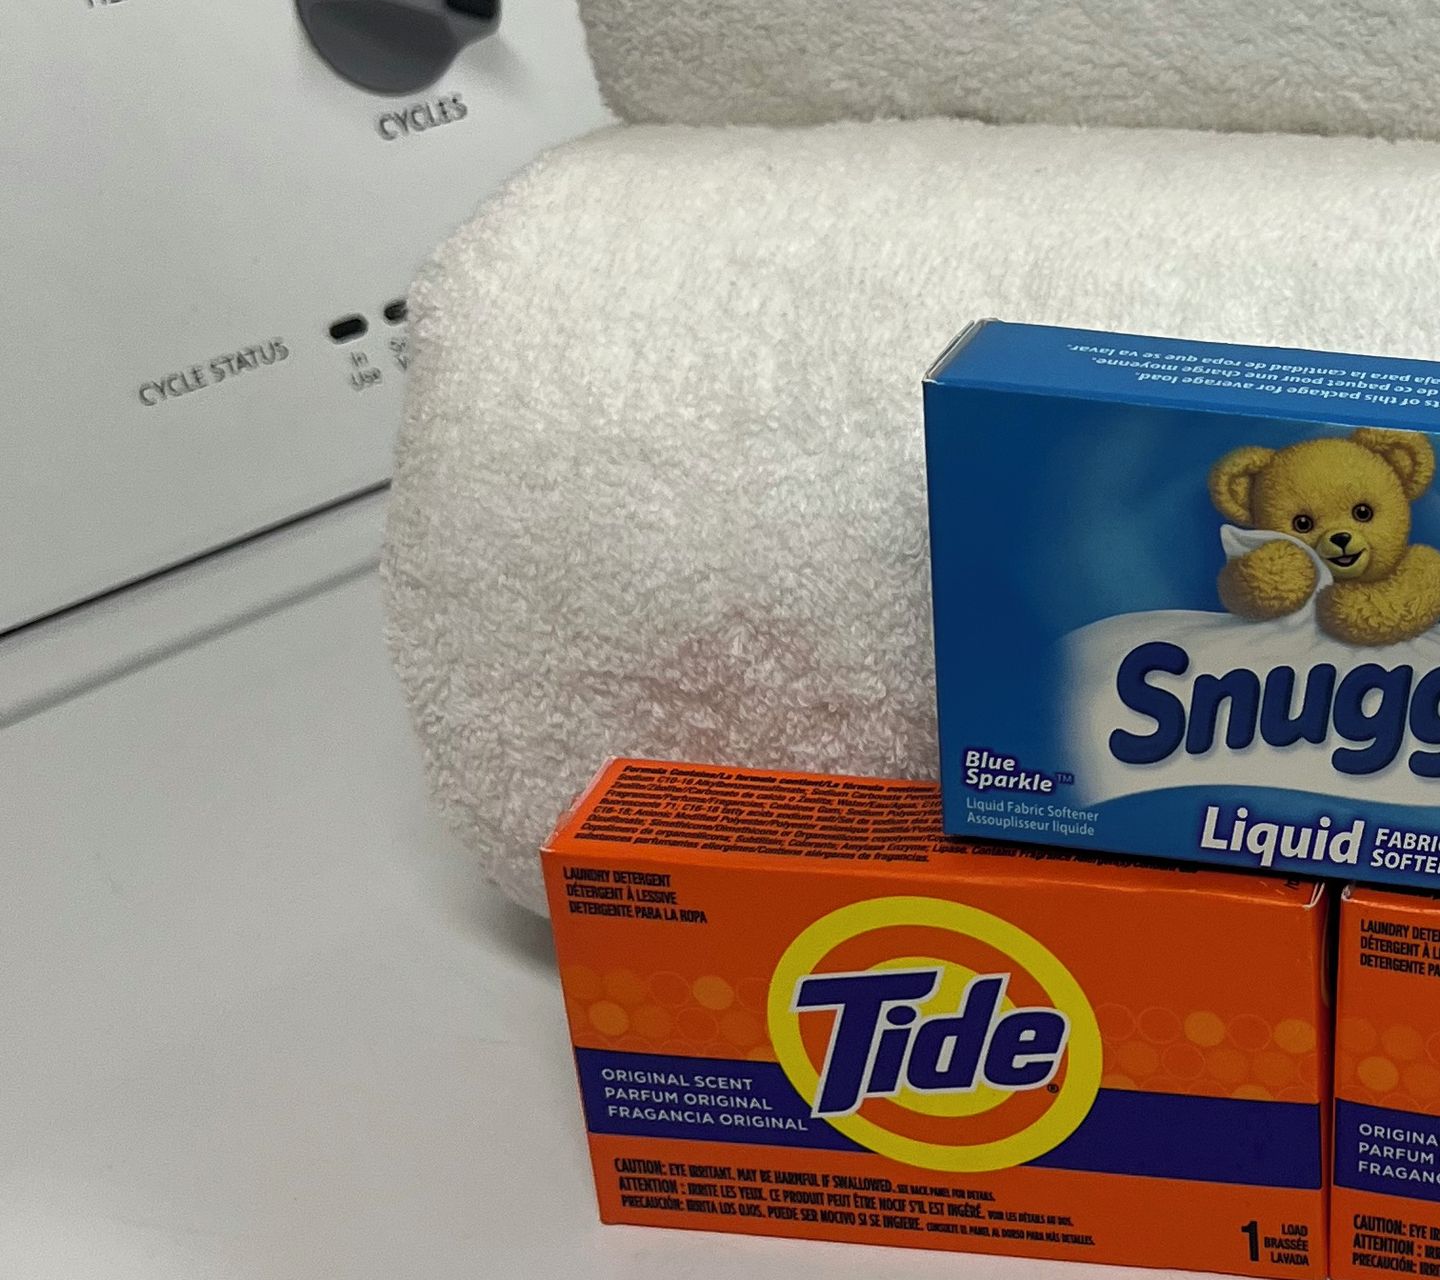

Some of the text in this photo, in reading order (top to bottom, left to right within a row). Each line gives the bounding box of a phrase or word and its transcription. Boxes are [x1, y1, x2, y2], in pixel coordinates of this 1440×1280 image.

[375, 94, 469, 141] CYCLES
[1067, 344, 1115, 356] lavar.
[1118, 349, 1138, 357] va
[1164, 354, 1198, 362] que
[1091, 356, 1178, 371] moyenne.
[1201, 357, 1241, 366] ropa
[1244, 361, 1266, 370] de
[1268, 363, 1346, 376] cantidad
[138, 337, 290, 407] CYCLE STATUS
[1135, 371, 1178, 384] load.
[1181, 365, 1241, 377] charge
[1244, 371, 1278, 380] une
[1280, 375, 1324, 384] pour
[1349, 370, 1367, 379] la
[1369, 372, 1411, 382] para
[1181, 375, 1254, 389] average
[1255, 383, 1282, 394] for
[1326, 379, 1391, 391] paquet
[1393, 385, 1413, 393] ce
[1286, 385, 1361, 399] package
[1364, 393, 1397, 404] this
[1415, 387, 1439, 397] de
[1398, 397, 1420, 406] of
[964, 750, 1016, 771] Blue
[964, 767, 1054, 792] Sparkle
[966, 796, 1100, 823] Liquid Fabric Softener
[966, 811, 1096, 836] Assouplisseur liquide
[1200, 805, 1367, 868] Liquid
[563, 867, 669, 886] LAUNDRY DETERGENT
[566, 881, 622, 899] DÉTERGENT
[636, 889, 676, 904] LESSIVE
[569, 900, 706, 922] DETERGENTE PARA LA ROPA
[1360, 919, 1409, 937] LAUNDRY
[1360, 935, 1419, 956] DÉTERGENT
[1360, 953, 1424, 974] DETERGENTE
[790, 966, 1070, 1118] Tide
[601, 1068, 751, 1089] ORIGINAL SCENT
[605, 1087, 771, 1109] PARFUM ORIGINAL
[608, 1105, 807, 1130] FRAGANCIA ORIGINAL
[1359, 1142, 1433, 1163] PARFUM
[614, 1158, 666, 1175] CAUTION:
[1281, 1223, 1309, 1237] LOAD
[1353, 1214, 1405, 1235] CAUTION:
[1409, 1224, 1426, 1238] EYE
[1240, 1220, 1260, 1262] 1
[1264, 1236, 1310, 1252] BRASSÉE
[1353, 1233, 1413, 1255] ATTENTION
[1270, 1250, 1310, 1267] LAVADA
[1352, 1252, 1416, 1272] PRECAUCIÓN:
